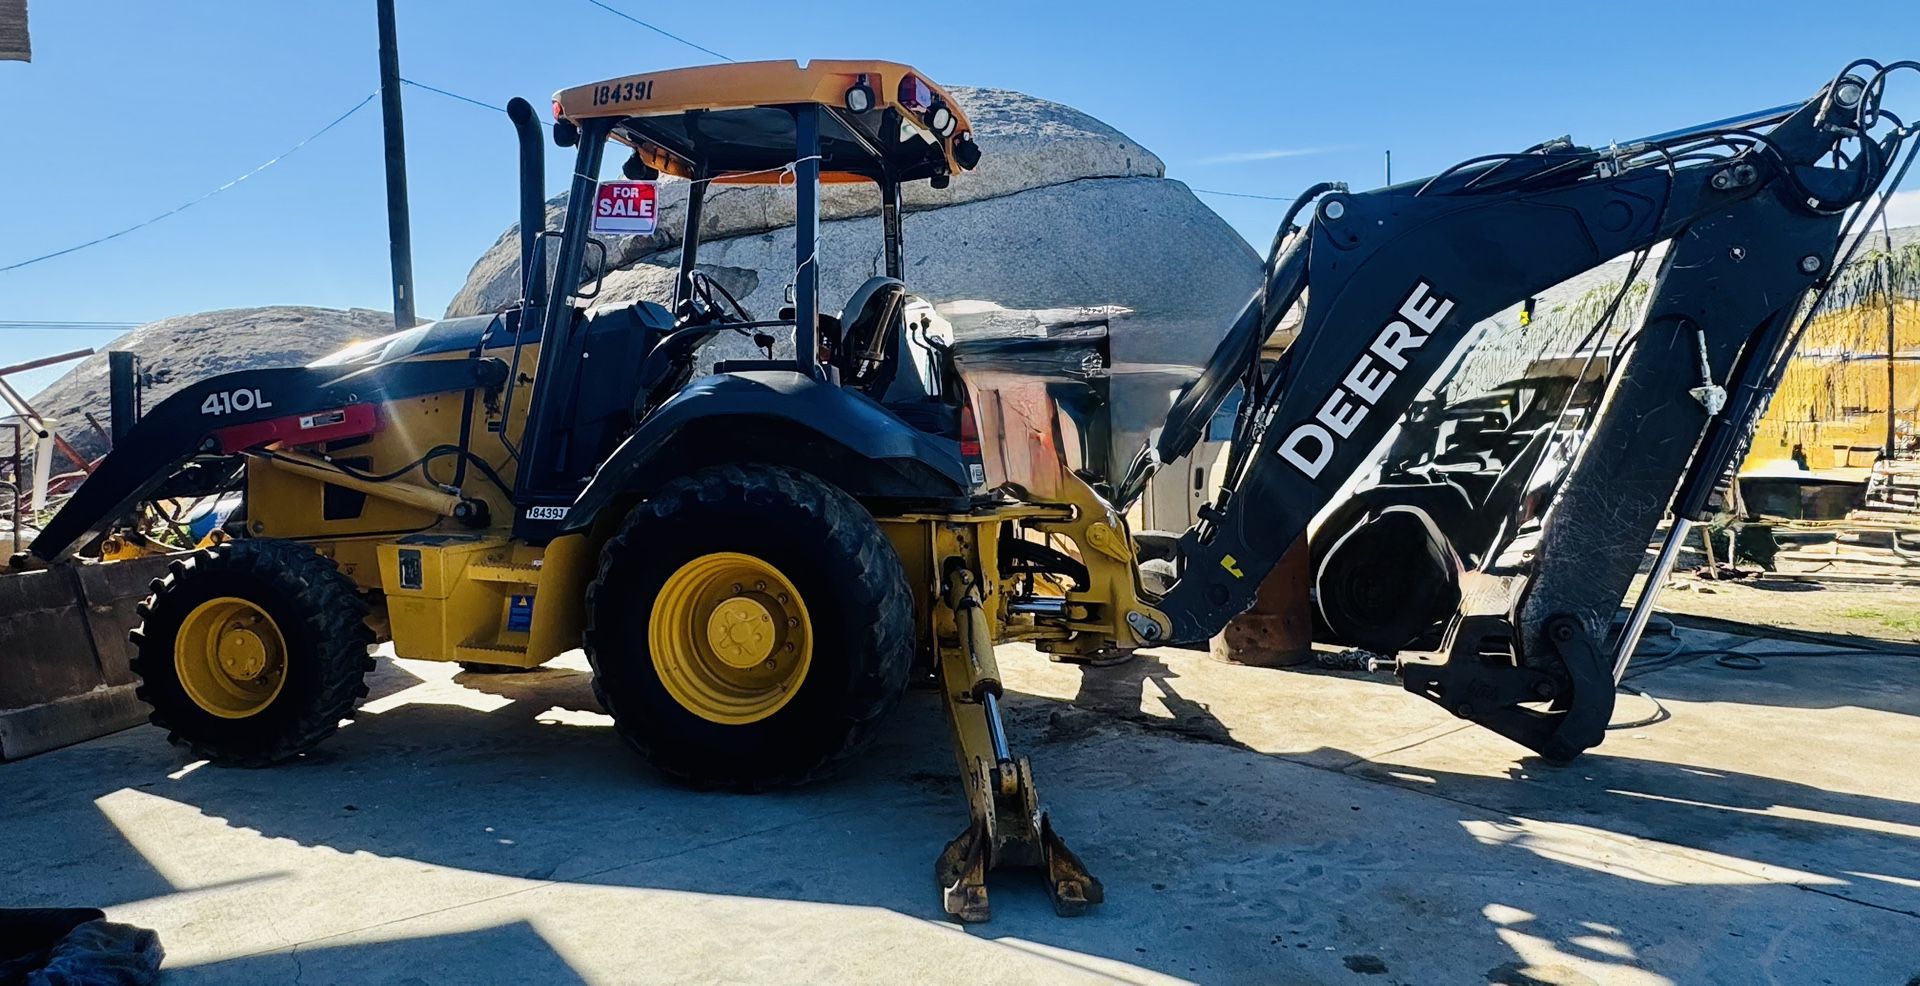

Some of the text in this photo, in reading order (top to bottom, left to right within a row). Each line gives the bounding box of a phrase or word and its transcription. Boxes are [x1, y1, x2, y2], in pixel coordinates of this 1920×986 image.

[593, 80, 653, 106] 184391
[613, 187, 639, 198] FOR
[599, 198, 653, 217] SALE
[1277, 281, 1455, 480] DEERE
[201, 388, 272, 415] 410L
